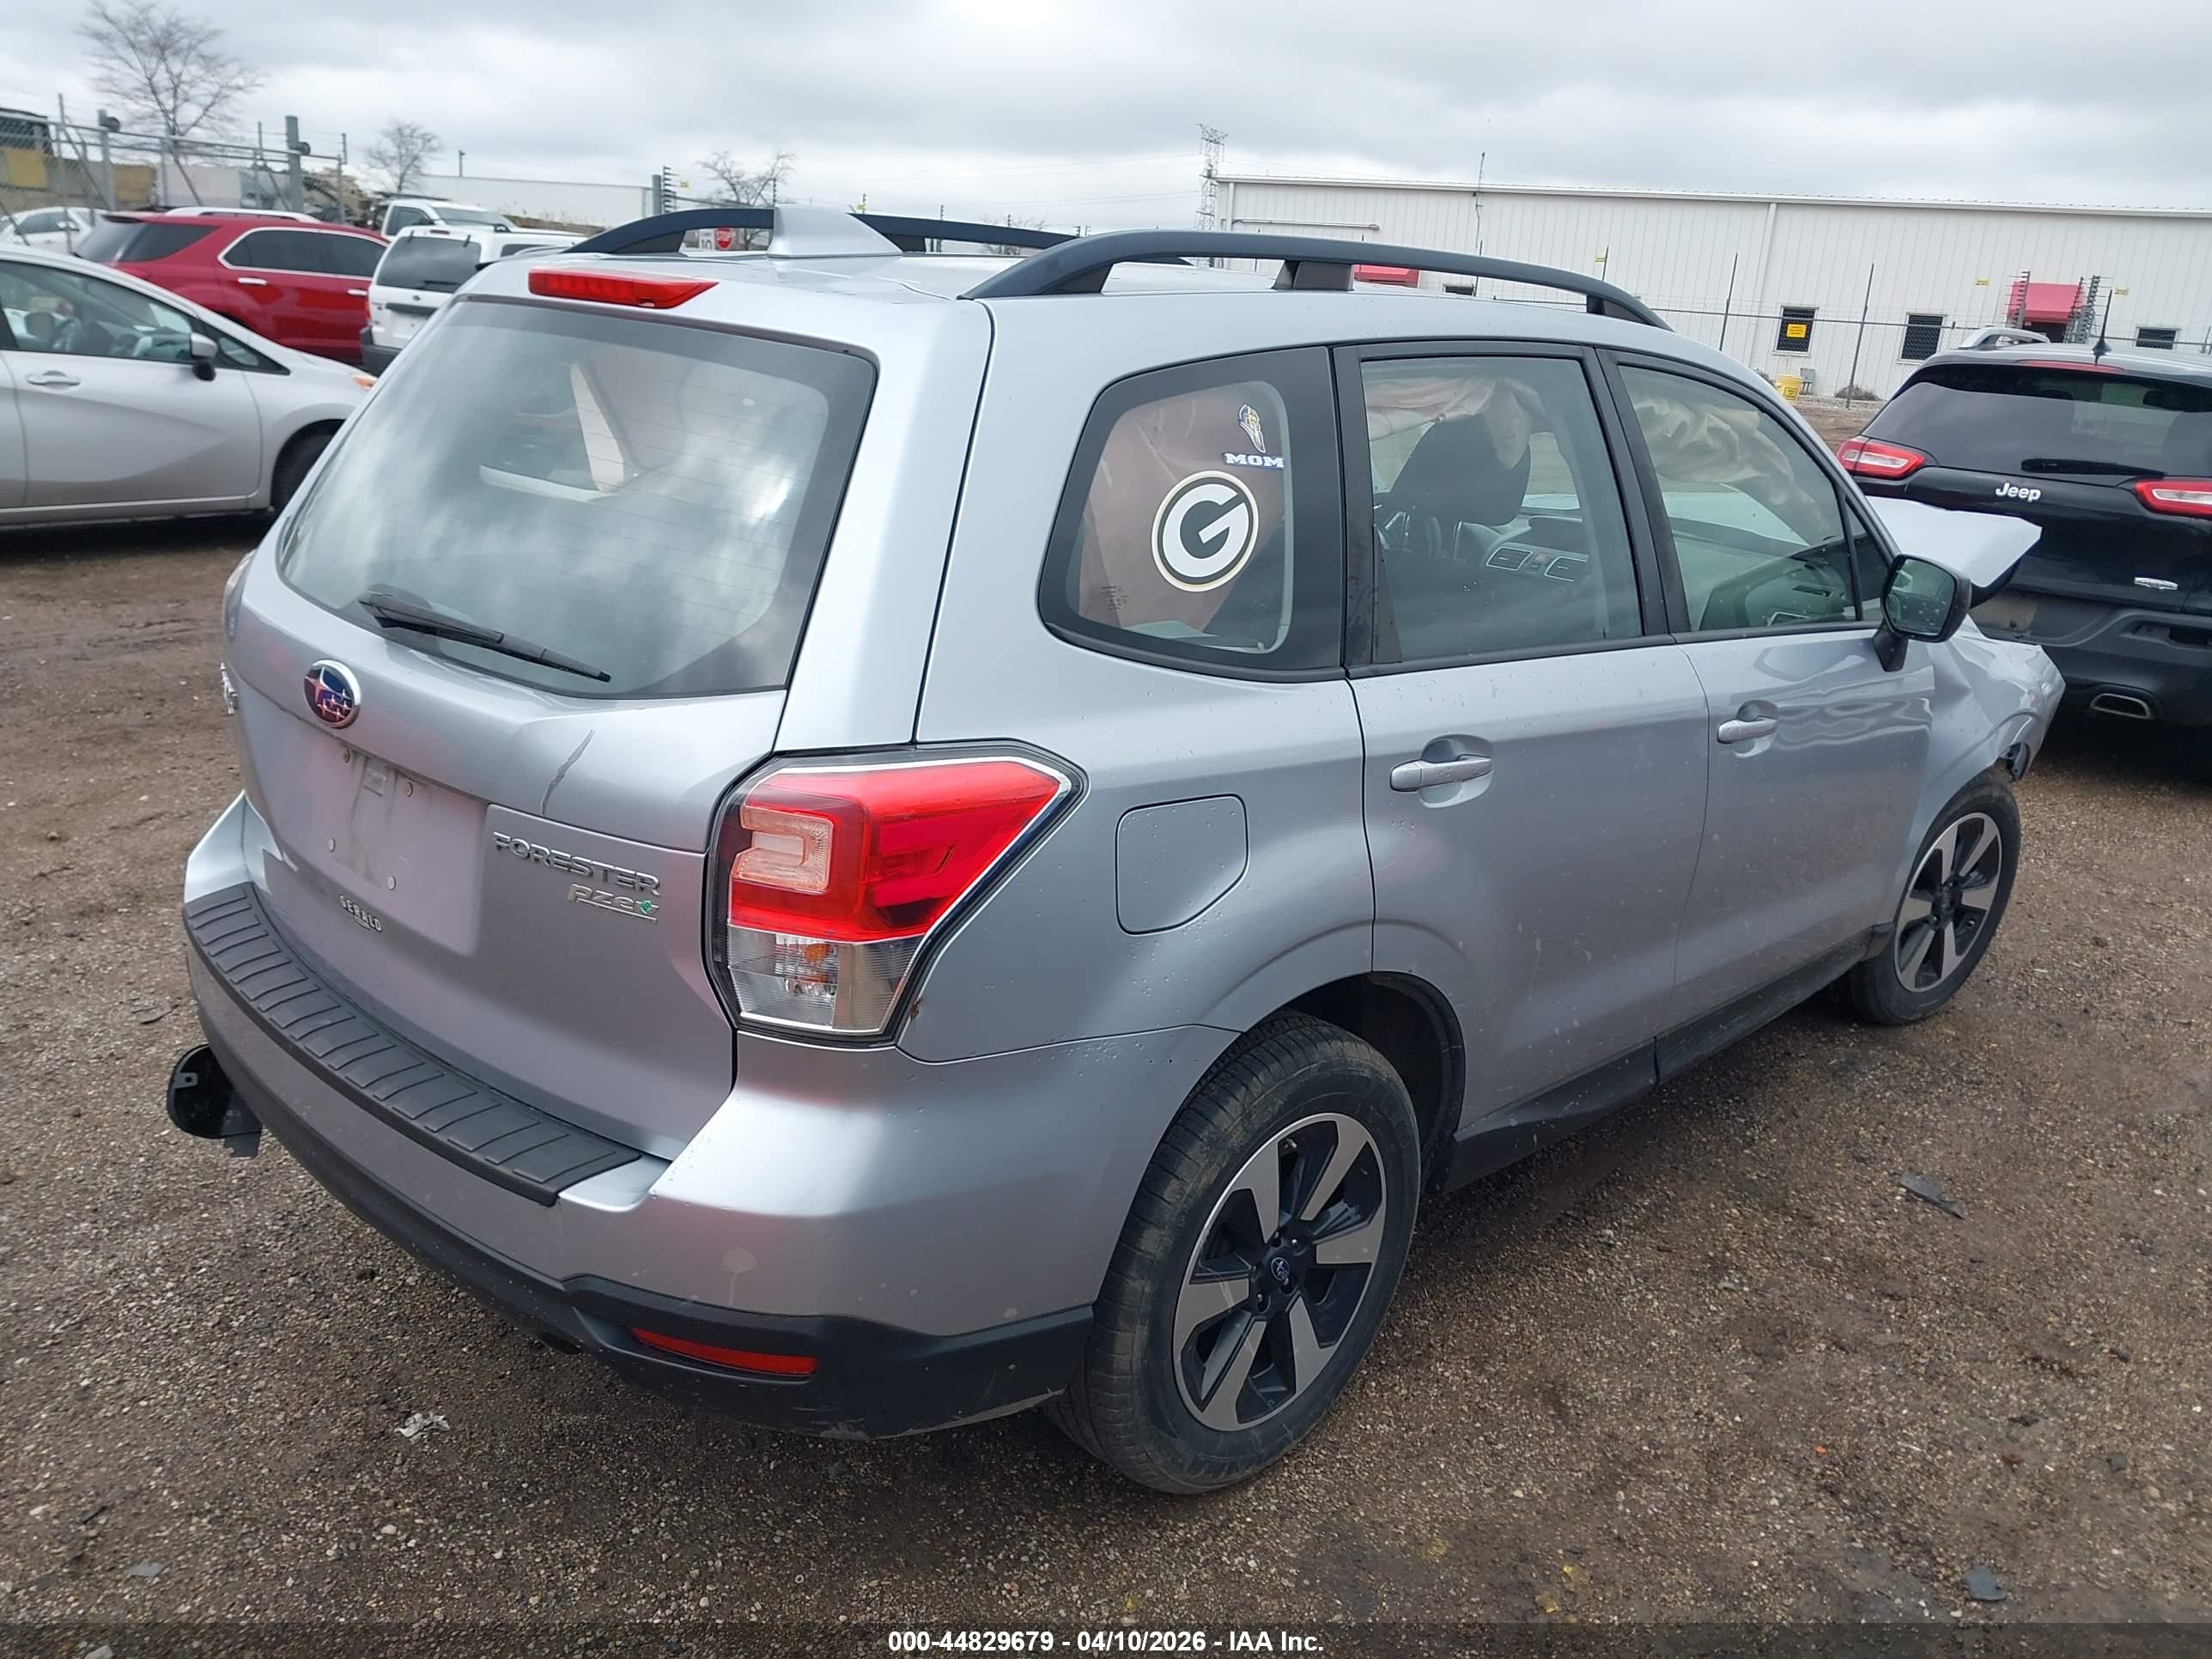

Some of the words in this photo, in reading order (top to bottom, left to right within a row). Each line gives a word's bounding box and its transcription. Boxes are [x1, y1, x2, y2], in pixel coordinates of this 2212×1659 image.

[716, 230, 732, 241] STOP
[1224, 453, 1285, 468] MOM
[1996, 483, 2041, 502] Jeep
[1162, 483, 1249, 578] G
[493, 831, 661, 896] FORESTER
[339, 895, 382, 933] GERALD
